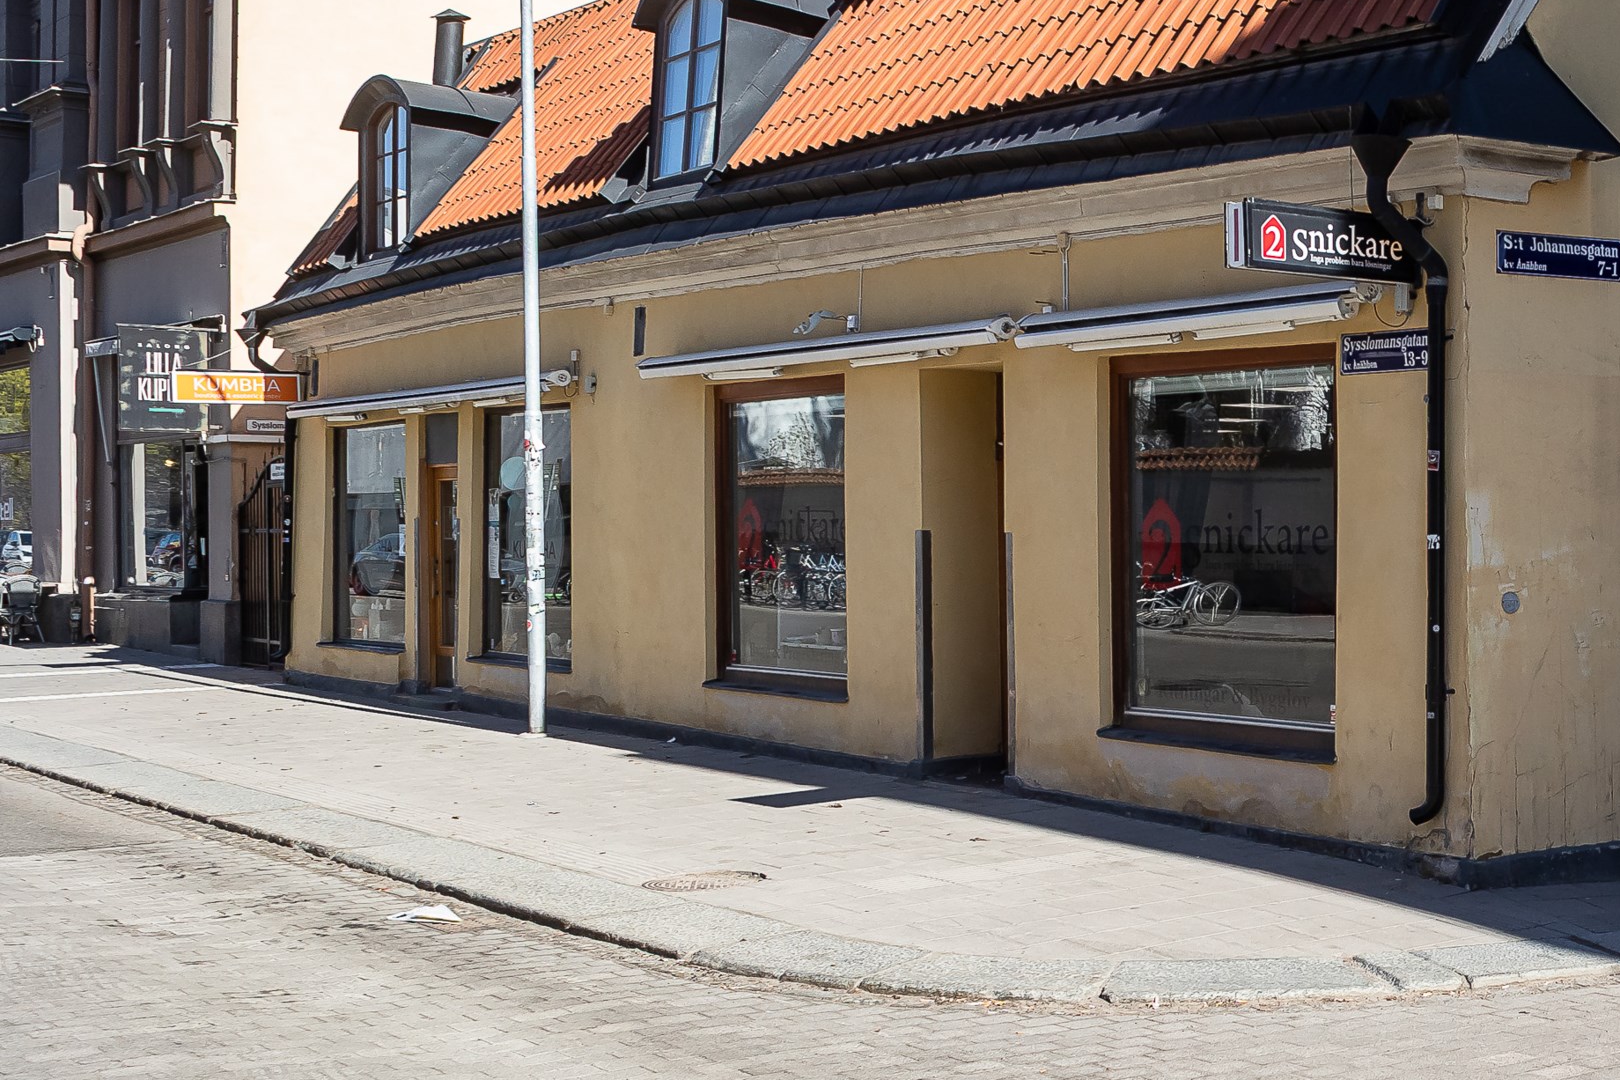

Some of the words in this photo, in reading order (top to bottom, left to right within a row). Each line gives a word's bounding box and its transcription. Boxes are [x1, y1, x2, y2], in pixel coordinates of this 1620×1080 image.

[1265, 225, 1284, 258] 2
[1503, 234, 1524, 250] S:t
[1529, 237, 1619, 261] Johannesgatan
[1310, 253, 1325, 265] Inga
[1324, 255, 1350, 266] problem
[1350, 258, 1364, 267] bara
[1597, 260, 1618, 277] 7-1
[1343, 333, 1428, 356] Sysslomansgatan
[145, 351, 183, 375] LILLA
[1403, 350, 1428, 367] 13-9
[193, 377, 281, 392] KUMBHA
[251, 421, 286, 430] Sysslom
